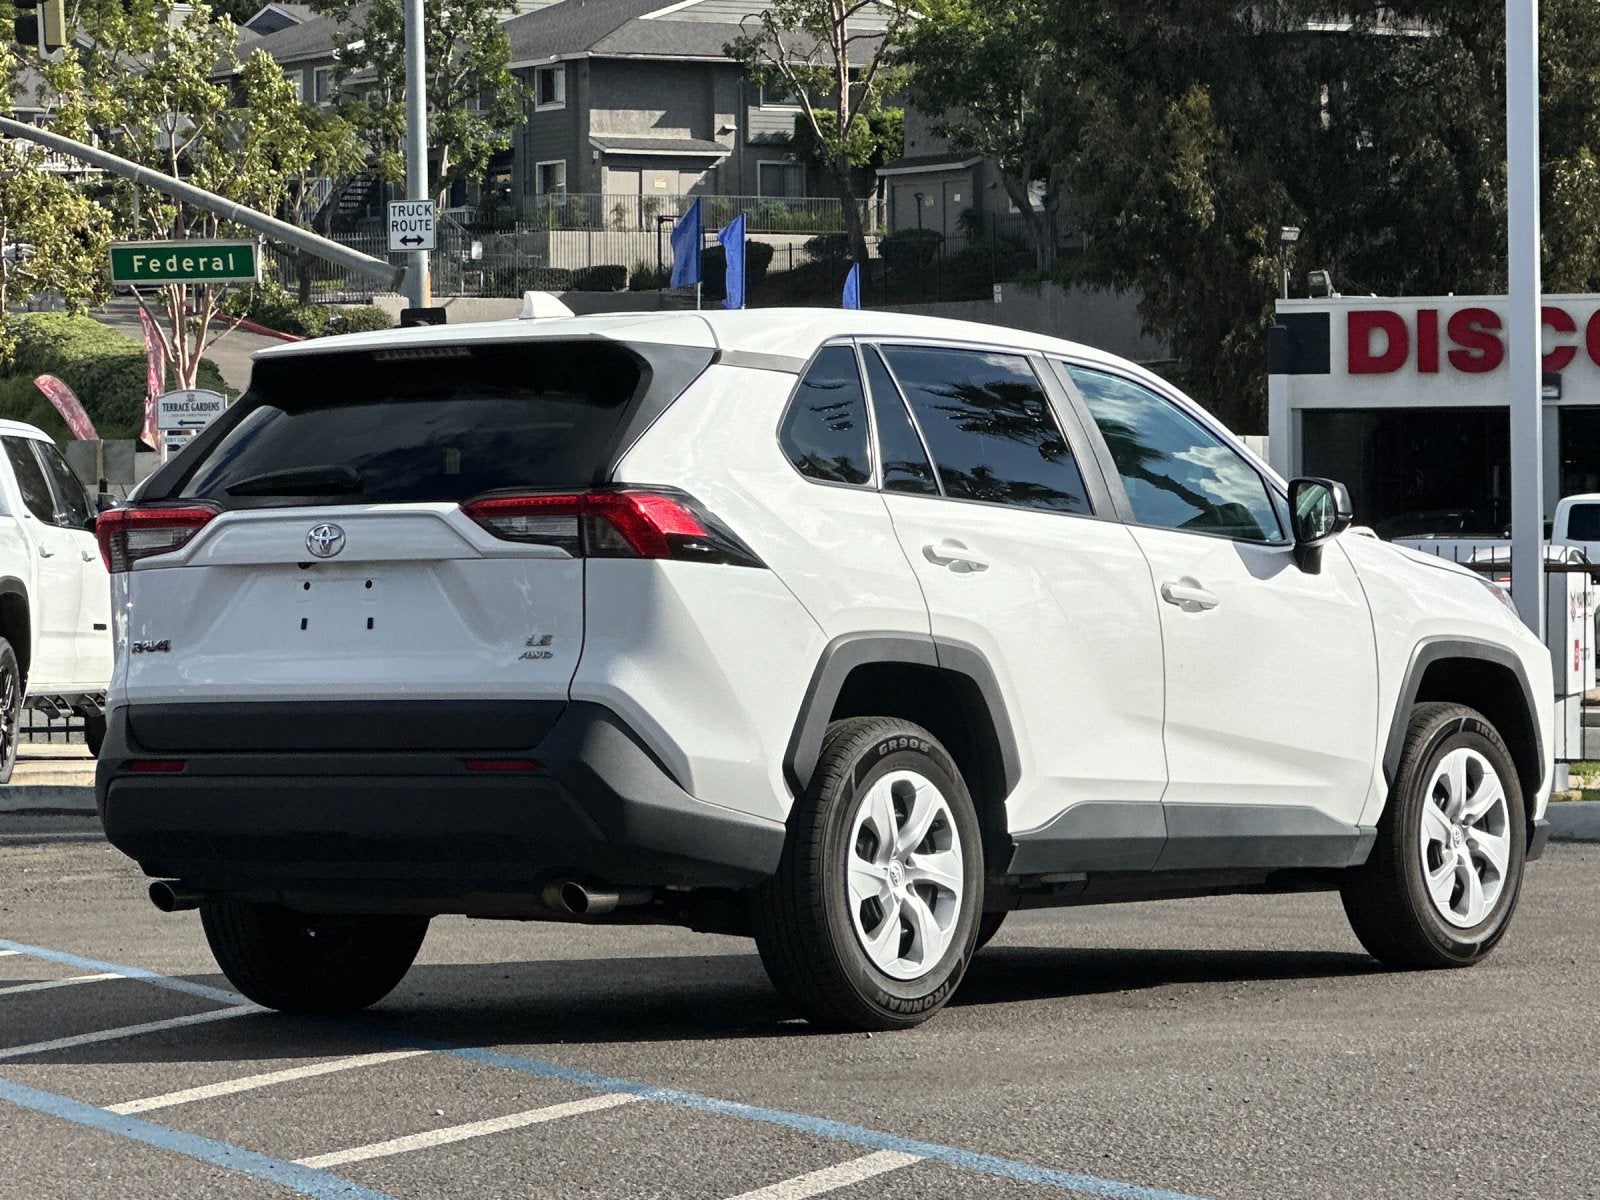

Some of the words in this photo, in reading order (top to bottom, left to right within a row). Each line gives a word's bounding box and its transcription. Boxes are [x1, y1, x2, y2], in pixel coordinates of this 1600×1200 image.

[391, 204, 432, 217] TRUCK
[391, 219, 432, 232] ROUTE
[132, 253, 234, 273] Federal
[162, 402, 190, 412] TERRACE
[191, 401, 220, 411] GARDENS
[878, 737, 932, 756] GR906
